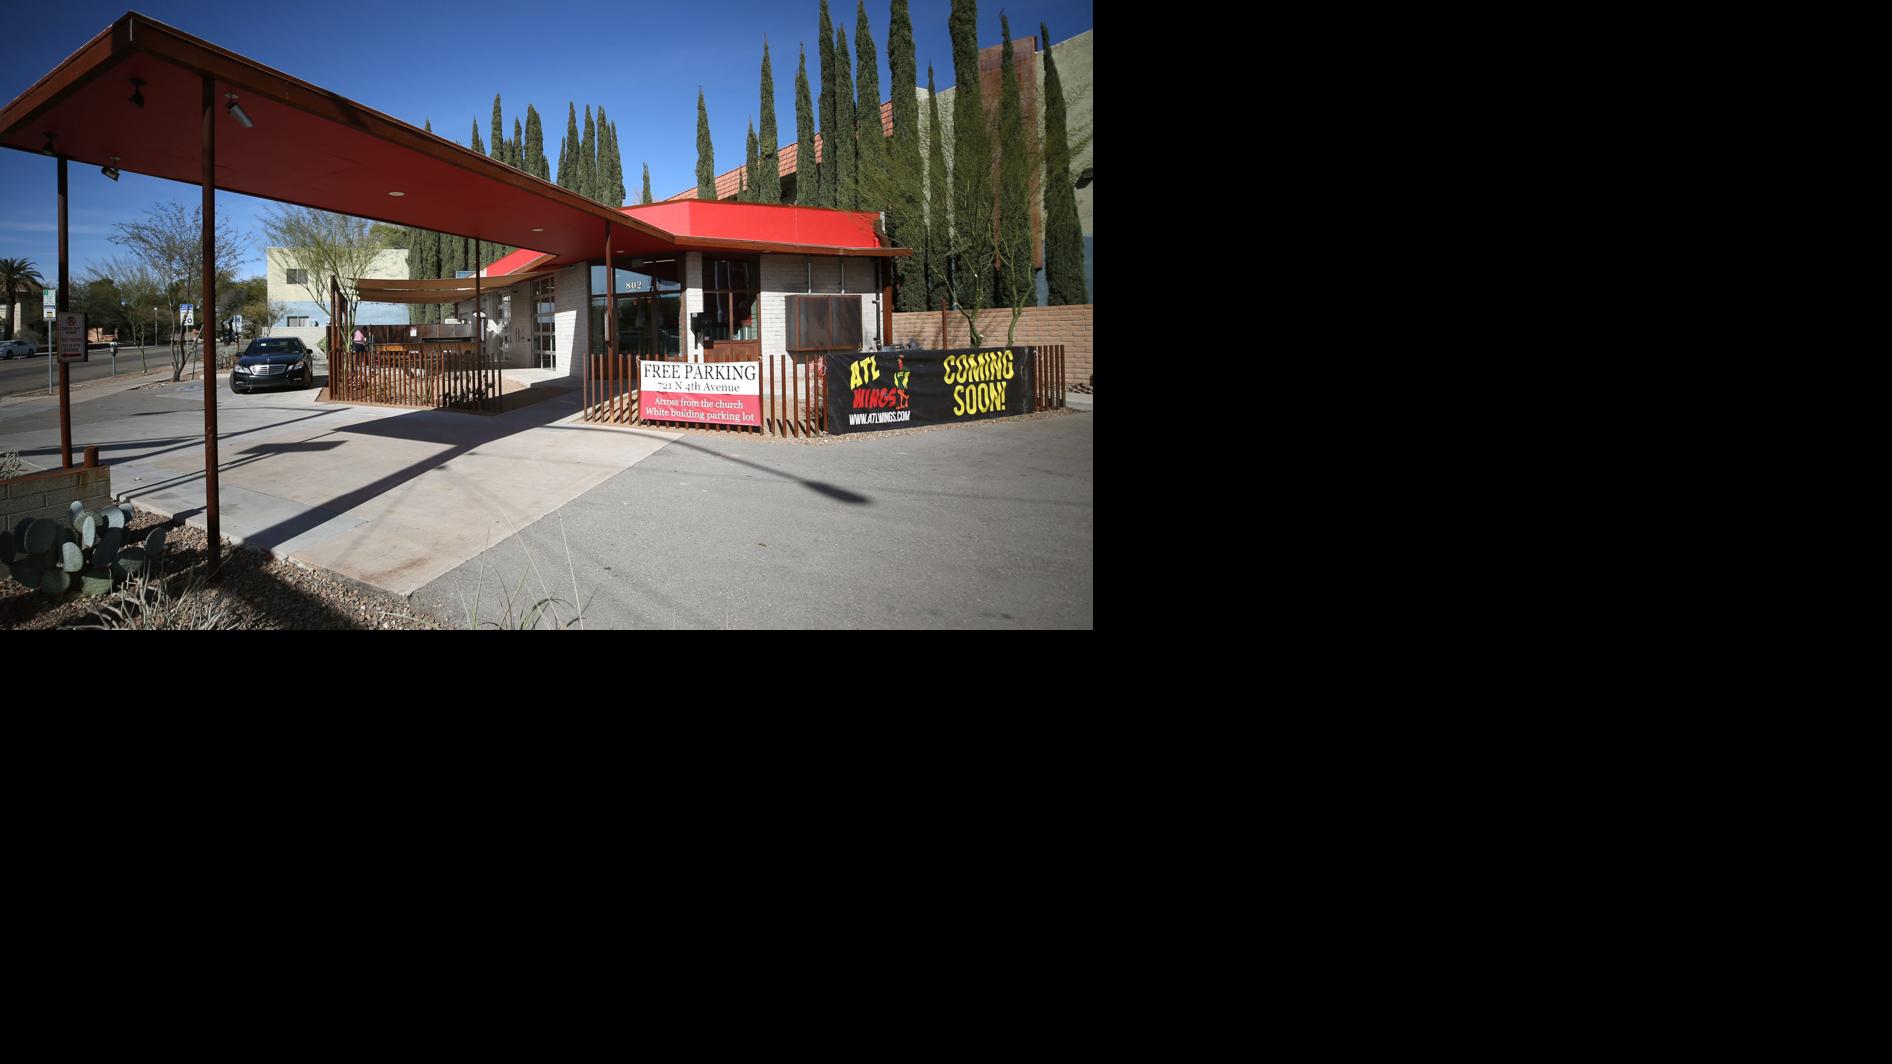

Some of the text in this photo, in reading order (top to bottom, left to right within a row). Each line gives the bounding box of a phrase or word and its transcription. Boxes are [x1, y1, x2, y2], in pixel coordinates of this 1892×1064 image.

[625, 281, 642, 289] 802
[644, 364, 756, 381] FREE PARKING
[850, 355, 880, 391] ATL
[943, 349, 1014, 385] COMING
[657, 381, 740, 393] 721 N 4th Avenue
[654, 396, 744, 409] Across from the church
[852, 387, 897, 409] WINGS
[953, 381, 1007, 416] SOON!
[645, 407, 755, 423] White building parking lot
[849, 410, 911, 426] WWW.ATLWINGS.COM
